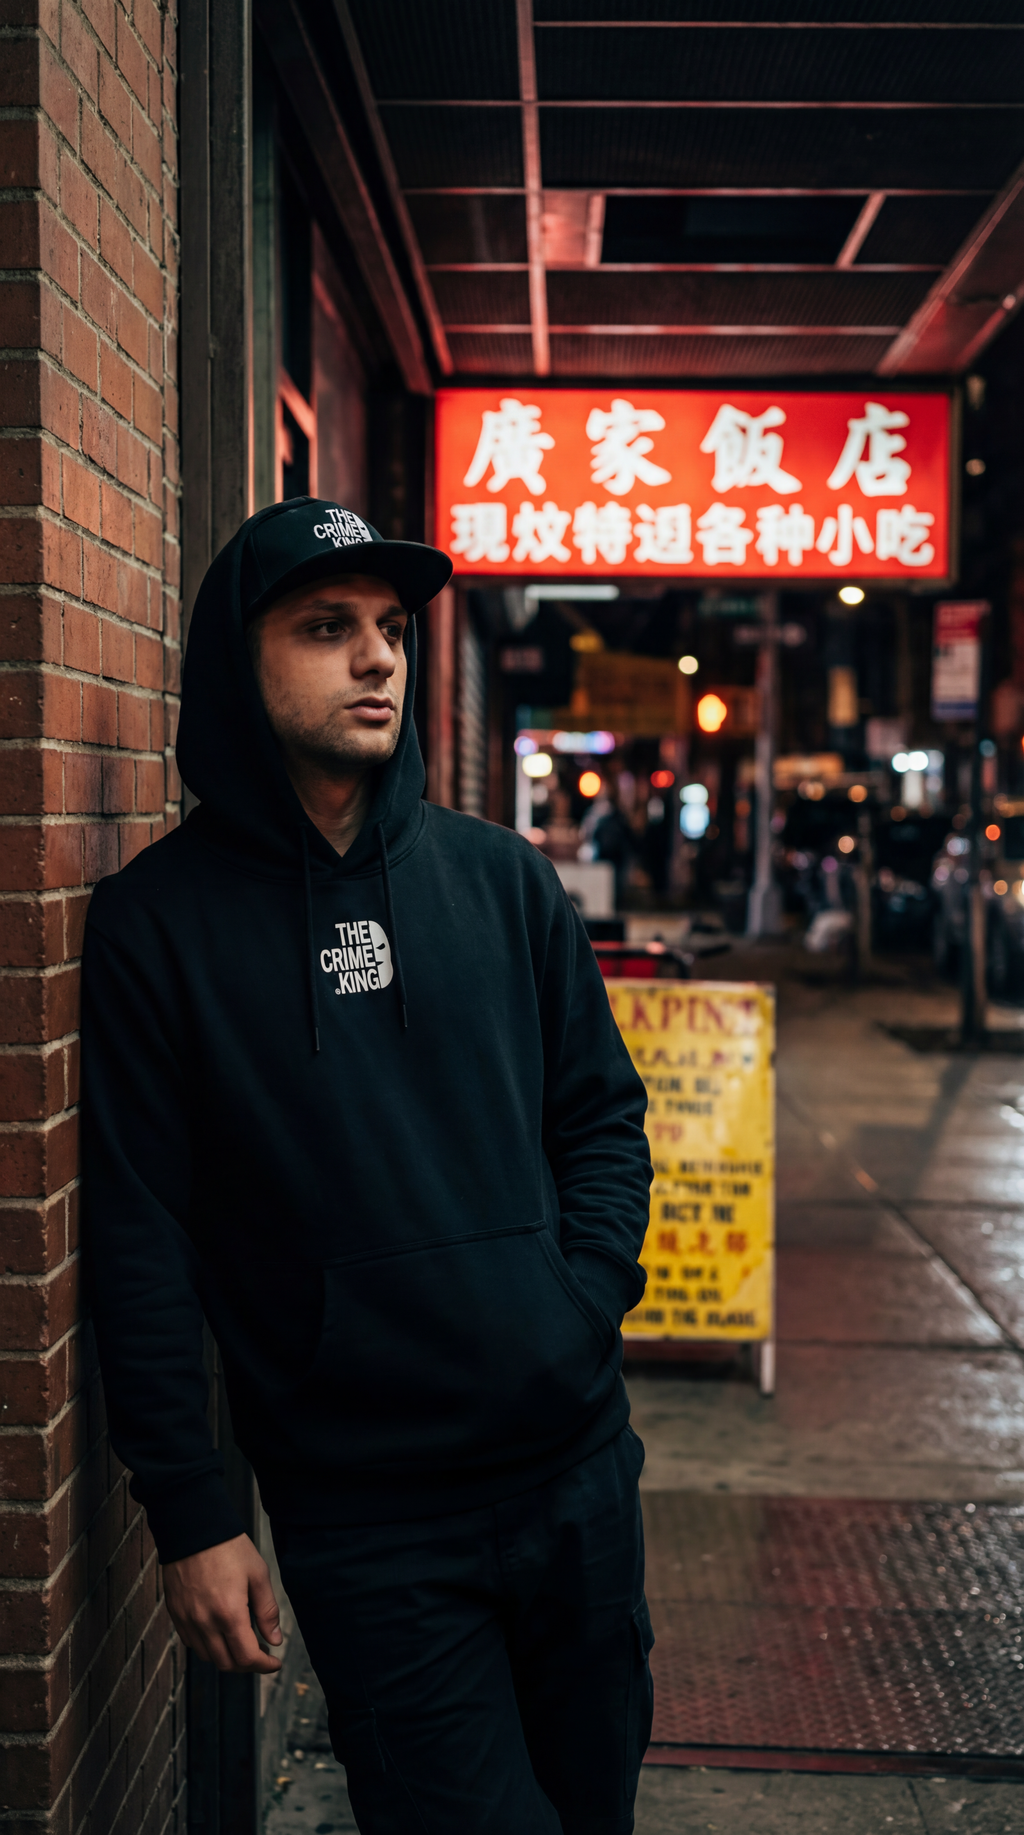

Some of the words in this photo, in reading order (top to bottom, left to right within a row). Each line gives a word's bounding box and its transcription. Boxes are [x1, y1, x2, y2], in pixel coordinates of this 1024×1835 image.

[463, 398, 911, 496] 廣家飯店
[325, 508, 356, 524] THE
[313, 522, 362, 539] CRIME
[335, 920, 371, 946] THE
[320, 944, 376, 973] CRIME
